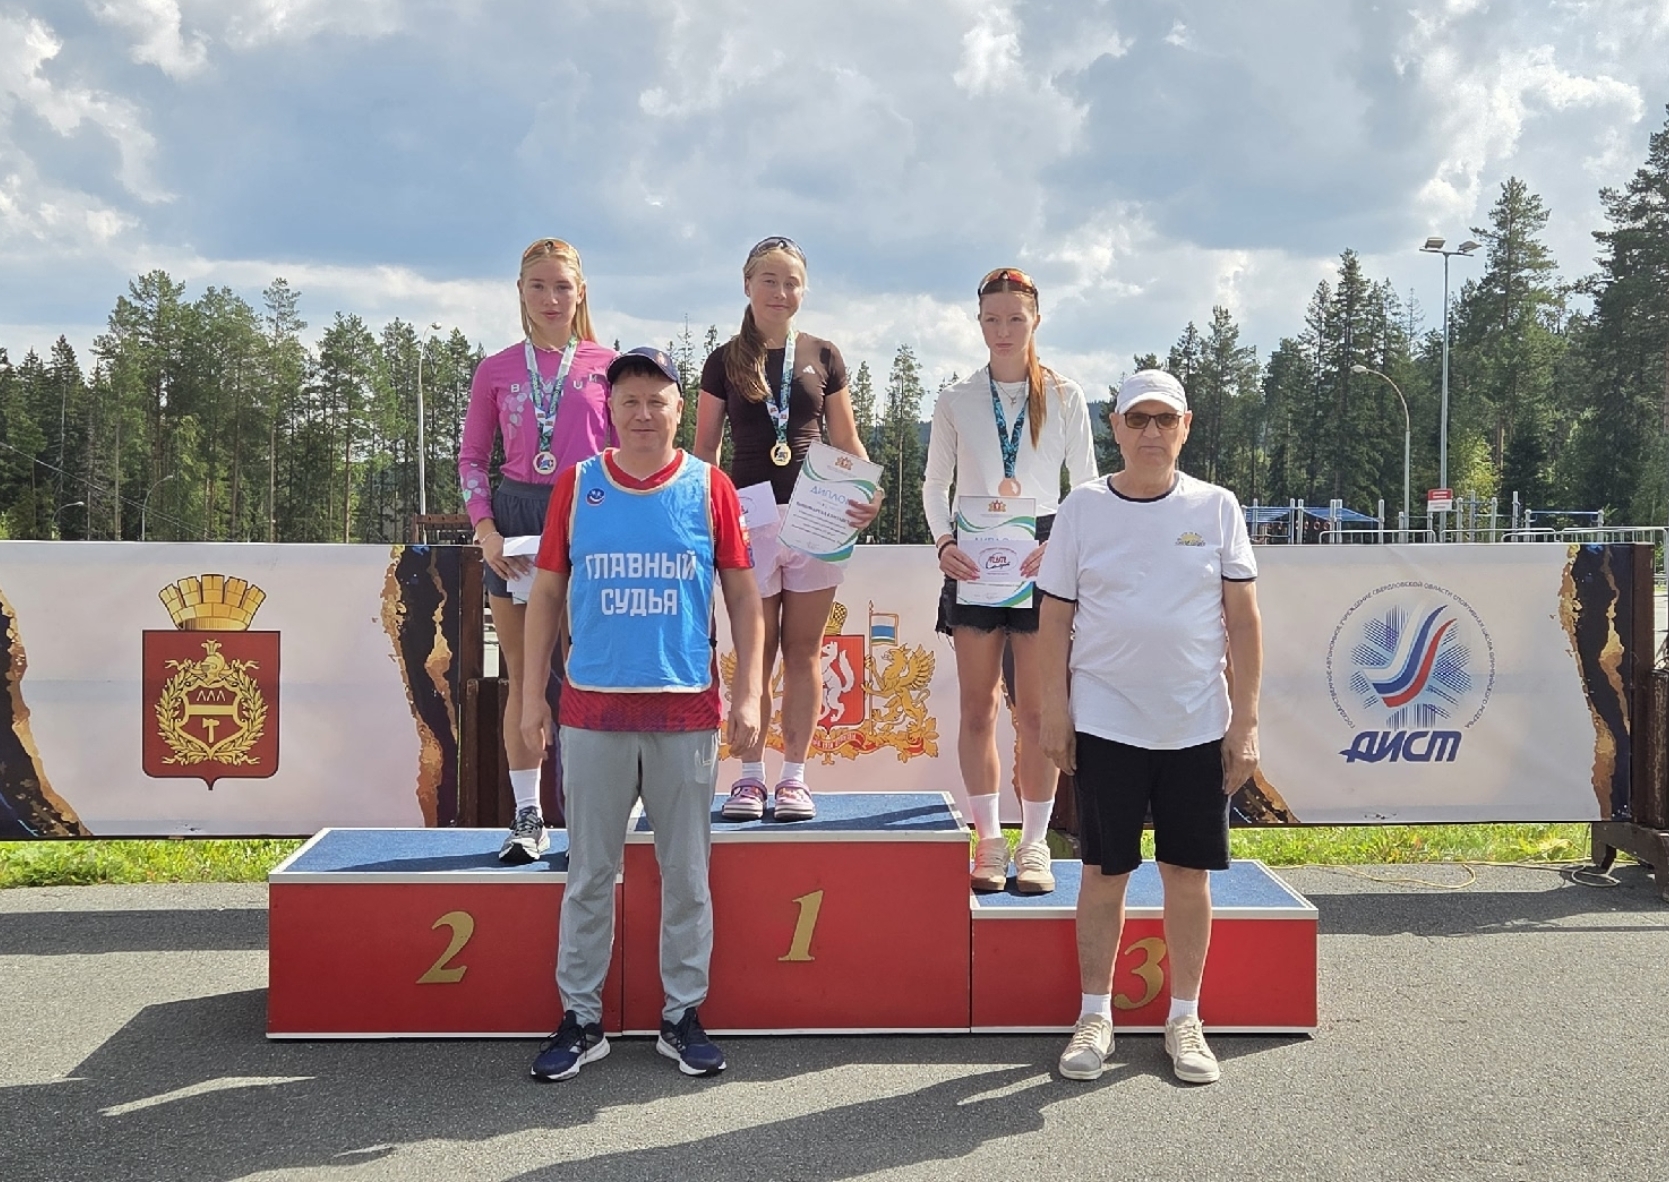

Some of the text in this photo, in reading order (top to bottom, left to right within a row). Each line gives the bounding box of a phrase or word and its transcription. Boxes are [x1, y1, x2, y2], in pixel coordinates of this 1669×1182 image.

[810, 485, 848, 505] ДИПЛО
[585, 550, 697, 580] ГЛАВНЫЙ
[601, 589, 678, 616] СУДЬЯ
[416, 911, 475, 984] 2
[778, 890, 824, 961] 1
[1113, 937, 1167, 1010] 3
